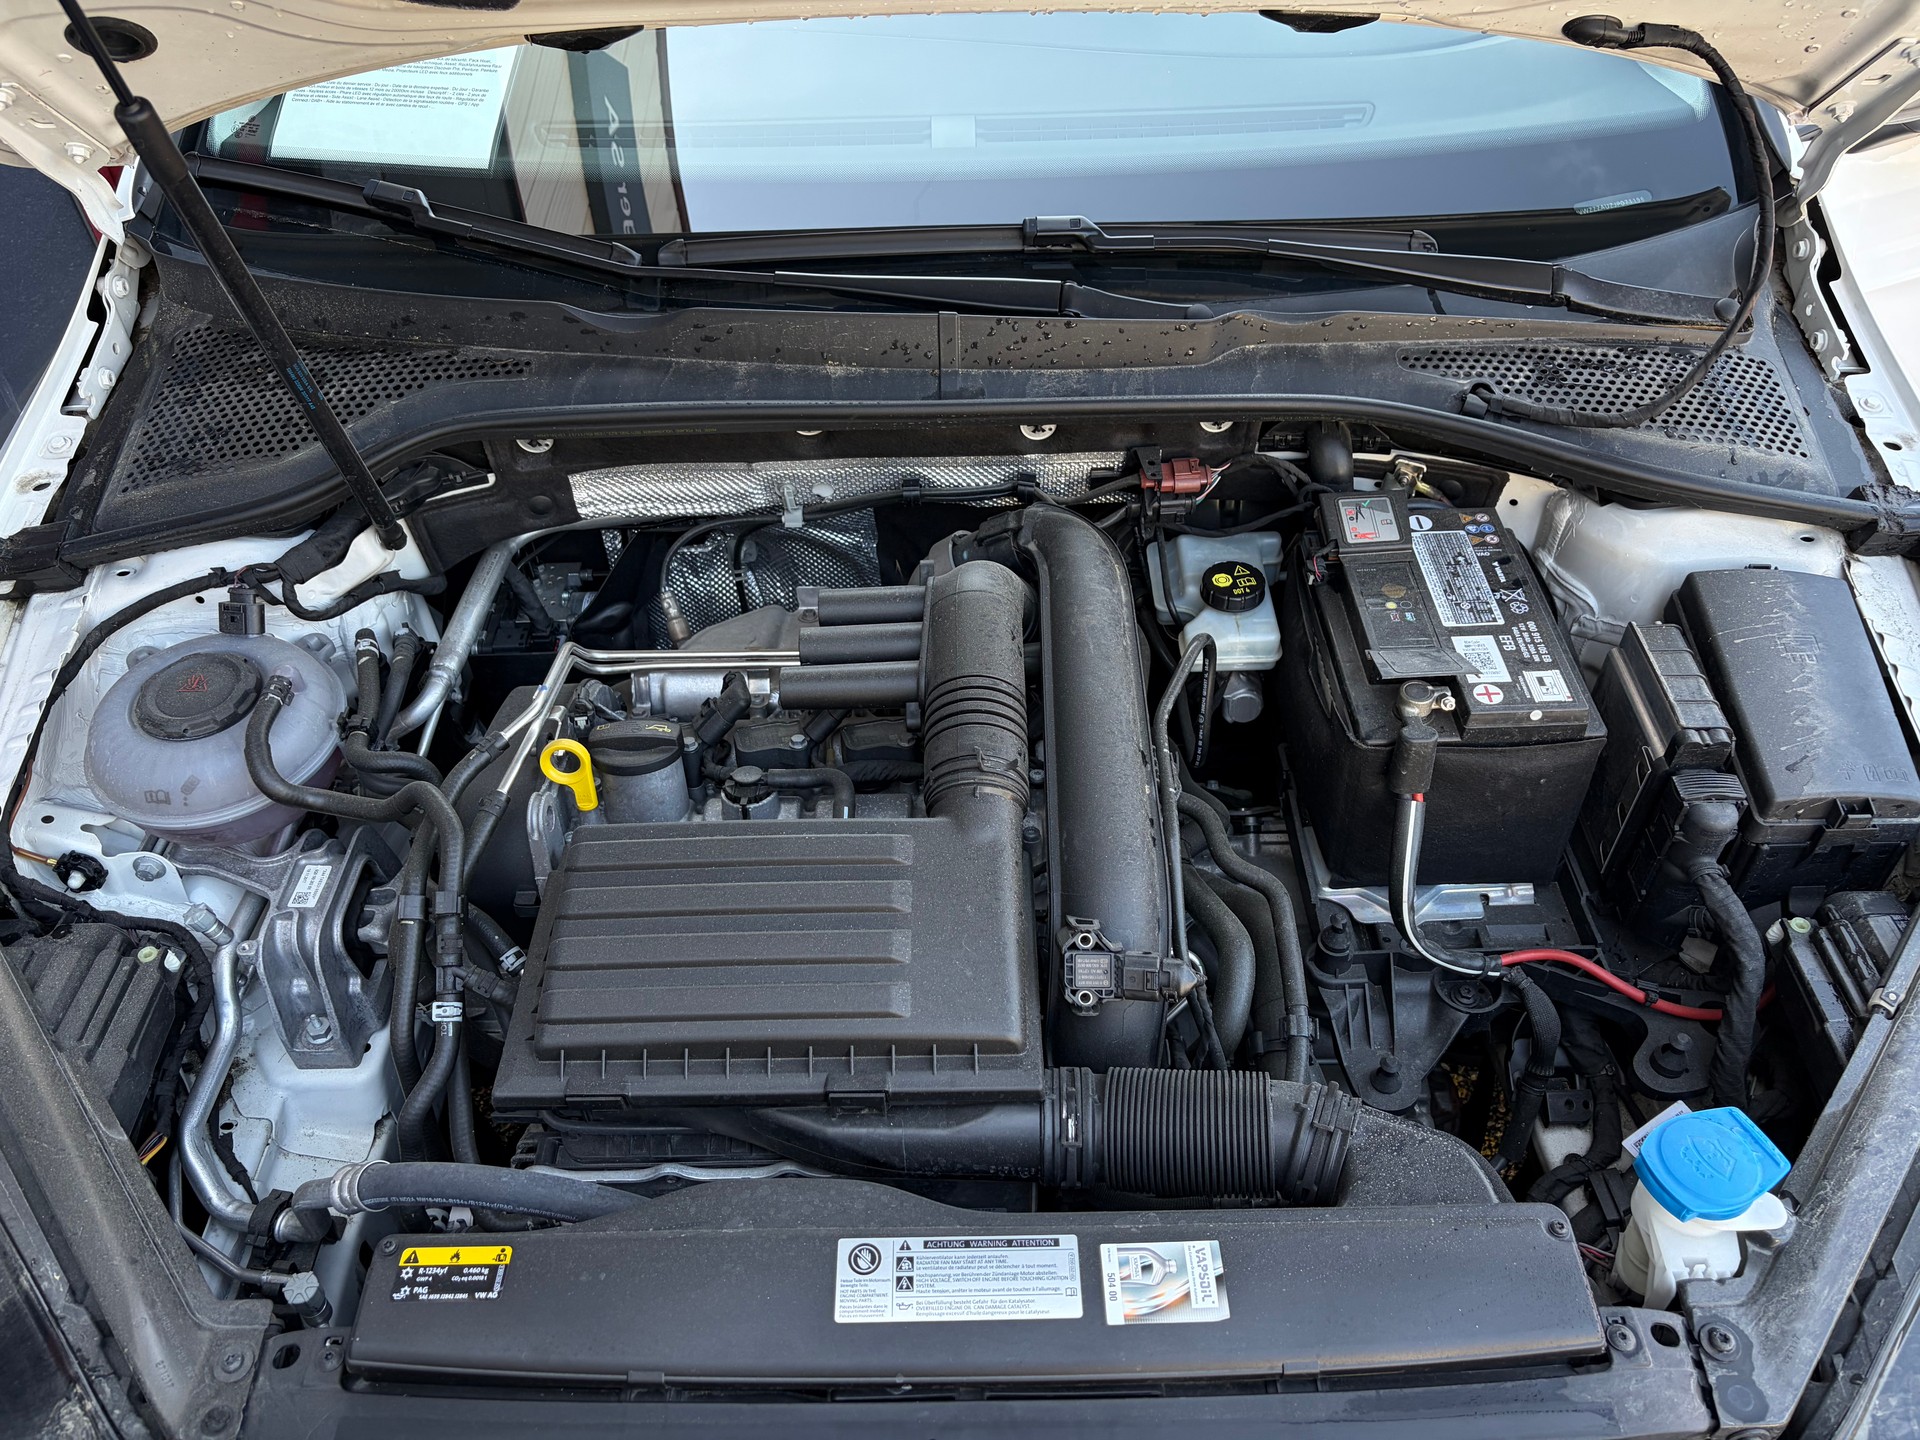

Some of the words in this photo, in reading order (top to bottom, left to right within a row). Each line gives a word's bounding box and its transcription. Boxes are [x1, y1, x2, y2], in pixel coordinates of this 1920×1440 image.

[1527, 621, 1538, 631] 000
[1499, 635, 1516, 650] EFB
[1531, 632, 1543, 643] 915
[1537, 644, 1548, 654] 105
[418, 1266, 449, 1276] R-1234yf
[1107, 1273, 1116, 1288] 504
[1109, 1290, 1117, 1302] 00
